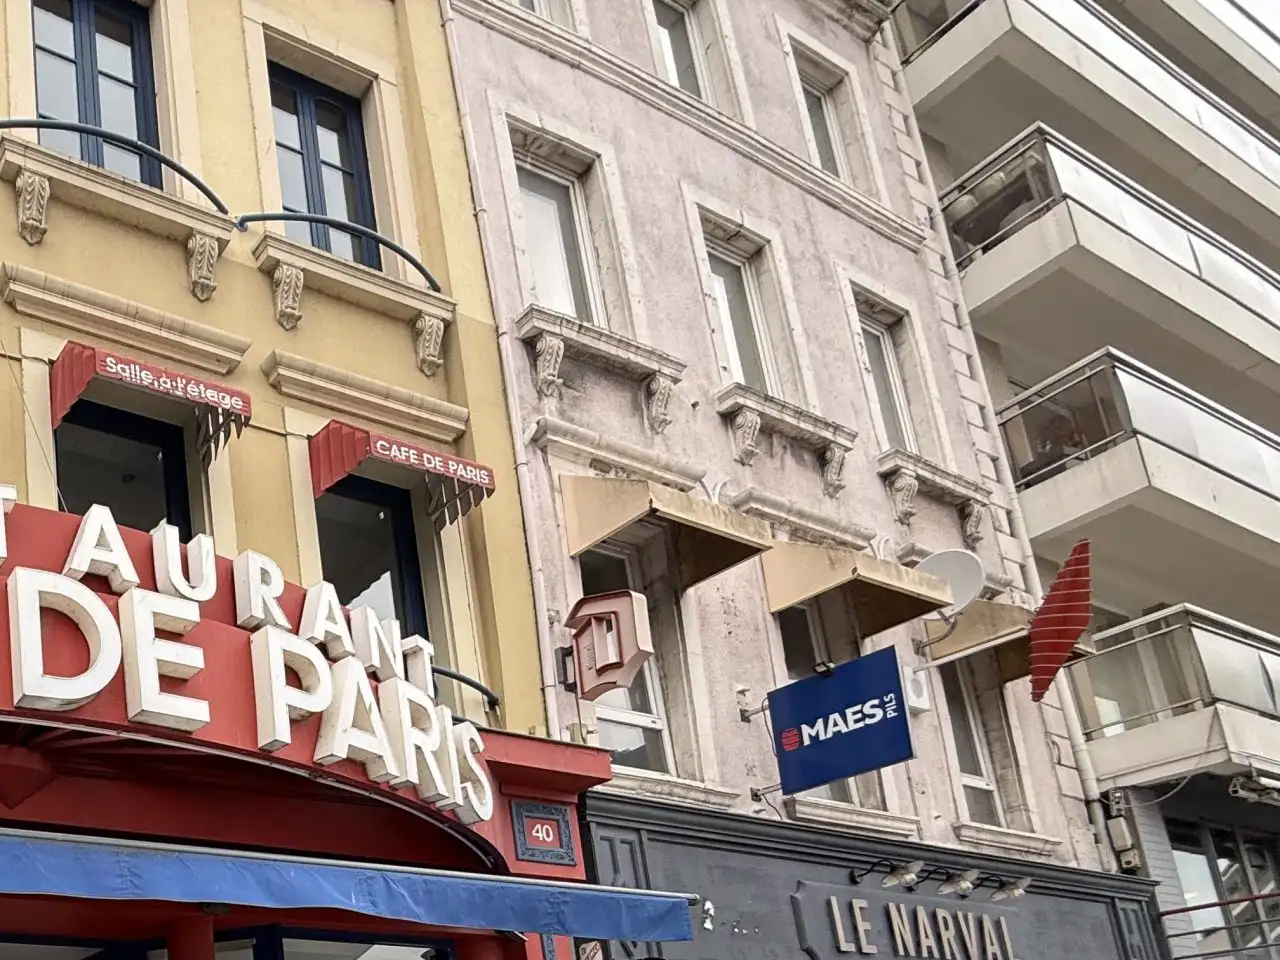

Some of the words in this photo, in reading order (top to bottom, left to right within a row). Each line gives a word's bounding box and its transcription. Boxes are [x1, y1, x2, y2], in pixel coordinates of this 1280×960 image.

[105, 356, 154, 383] Salle
[176, 376, 243, 409] l'étage
[376, 440, 419, 464] CAFE
[422, 453, 445, 471] DE
[448, 460, 490, 484] PARIS
[6, 565, 211, 733] DE
[250, 624, 494, 827] PARIS
[800, 698, 884, 747] MAES
[883, 693, 899, 719] PILS
[531, 823, 554, 842] 40
[830, 895, 878, 954] LE
